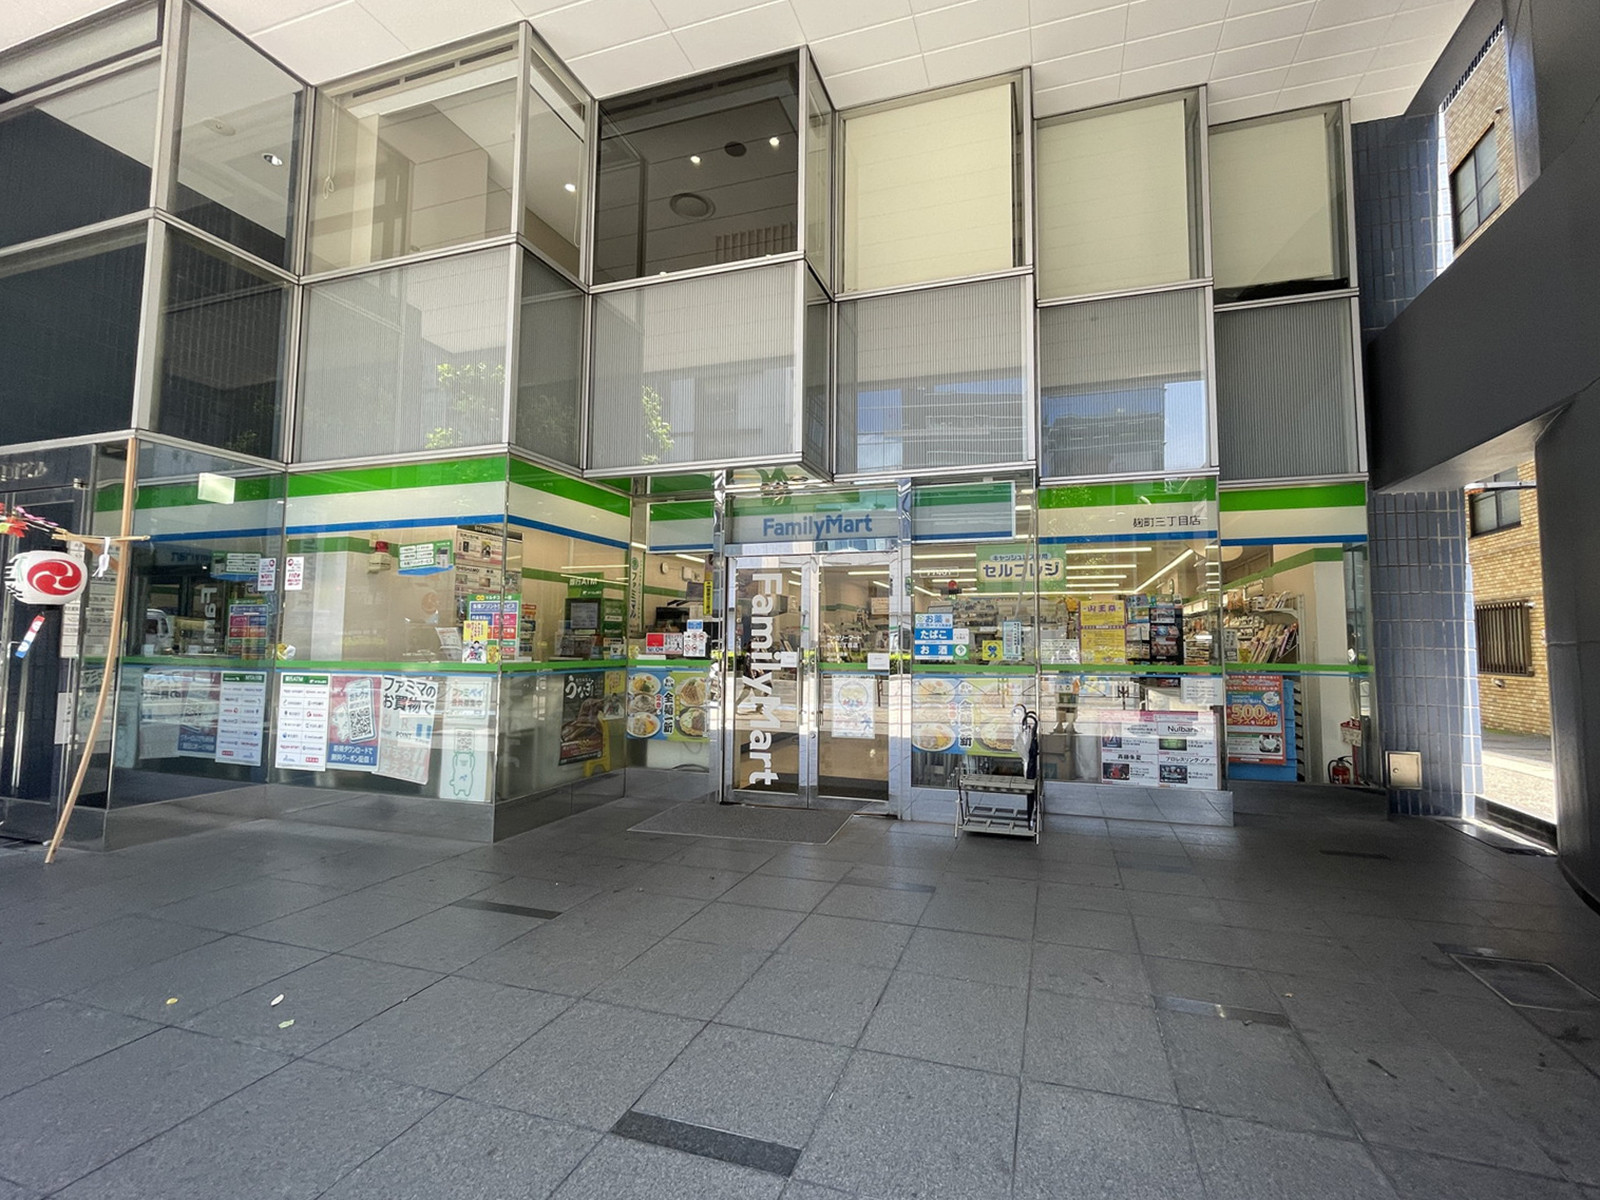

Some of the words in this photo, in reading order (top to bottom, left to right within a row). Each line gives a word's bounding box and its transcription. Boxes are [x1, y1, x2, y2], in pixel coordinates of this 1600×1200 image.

[763, 515, 873, 540] FamilyMart
[920, 630, 947, 640] たばこ
[920, 645, 948, 655] お酒
[383, 677, 436, 698] ファミマの
[742, 573, 783, 786] FamilyMart
[383, 693, 435, 715] お買物で
